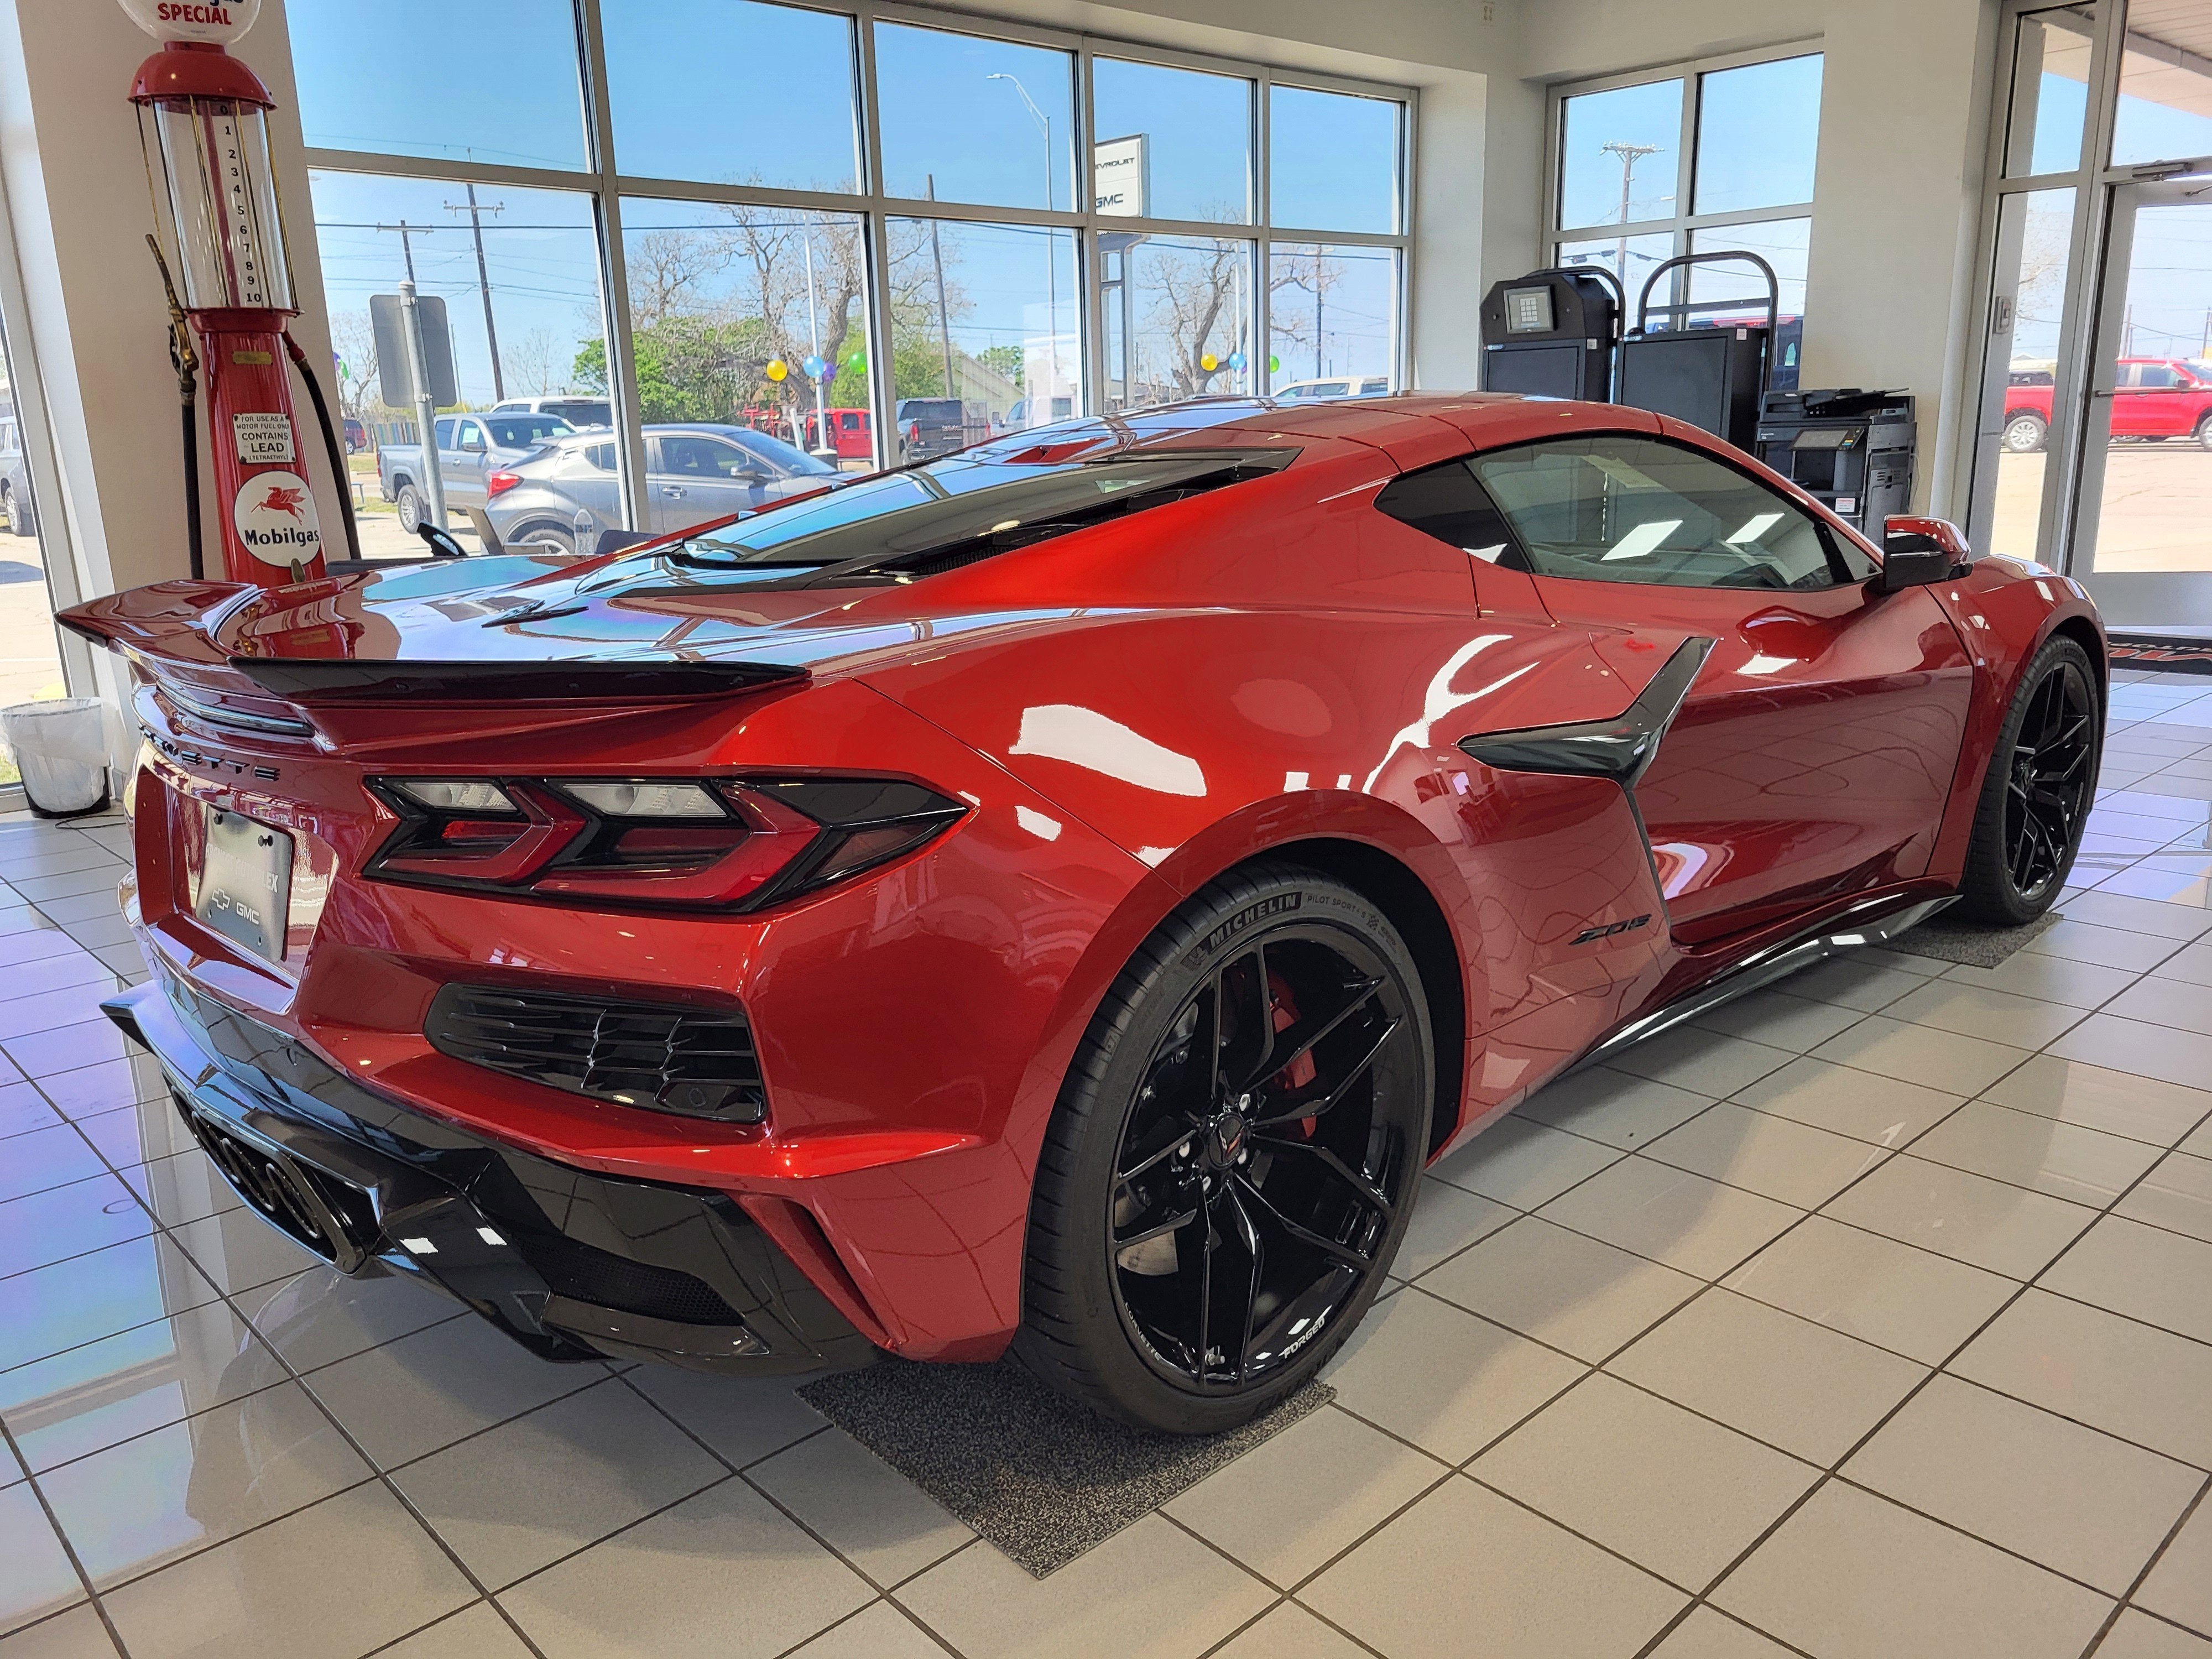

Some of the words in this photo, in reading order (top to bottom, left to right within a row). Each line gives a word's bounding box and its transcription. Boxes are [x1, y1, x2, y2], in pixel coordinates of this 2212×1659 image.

[158, 3, 232, 25] SPECIAL
[225, 126, 231, 135] 1
[228, 149, 236, 159] 2
[231, 168, 238, 176] 3
[233, 184, 241, 194] 4
[1096, 193, 1123, 208] GMC
[237, 205, 244, 215] 5
[239, 225, 247, 234] 6
[243, 243, 249, 252] 7
[246, 262, 253, 270] 8
[247, 276, 254, 285] 9
[247, 293, 261, 302] 10
[242, 431, 289, 440] CONTAINS
[251, 442, 285, 452] LEAD
[244, 527, 319, 547] Mobilgas
[1307, 895, 1330, 904] PILOT
[1332, 898, 1357, 912] SPORT
[236, 901, 260, 925] GMC
[1209, 894, 1297, 950] MICHELIN
[1125, 1302, 1162, 1360] CORVETTE
[1284, 1316, 1326, 1359] FORGED
